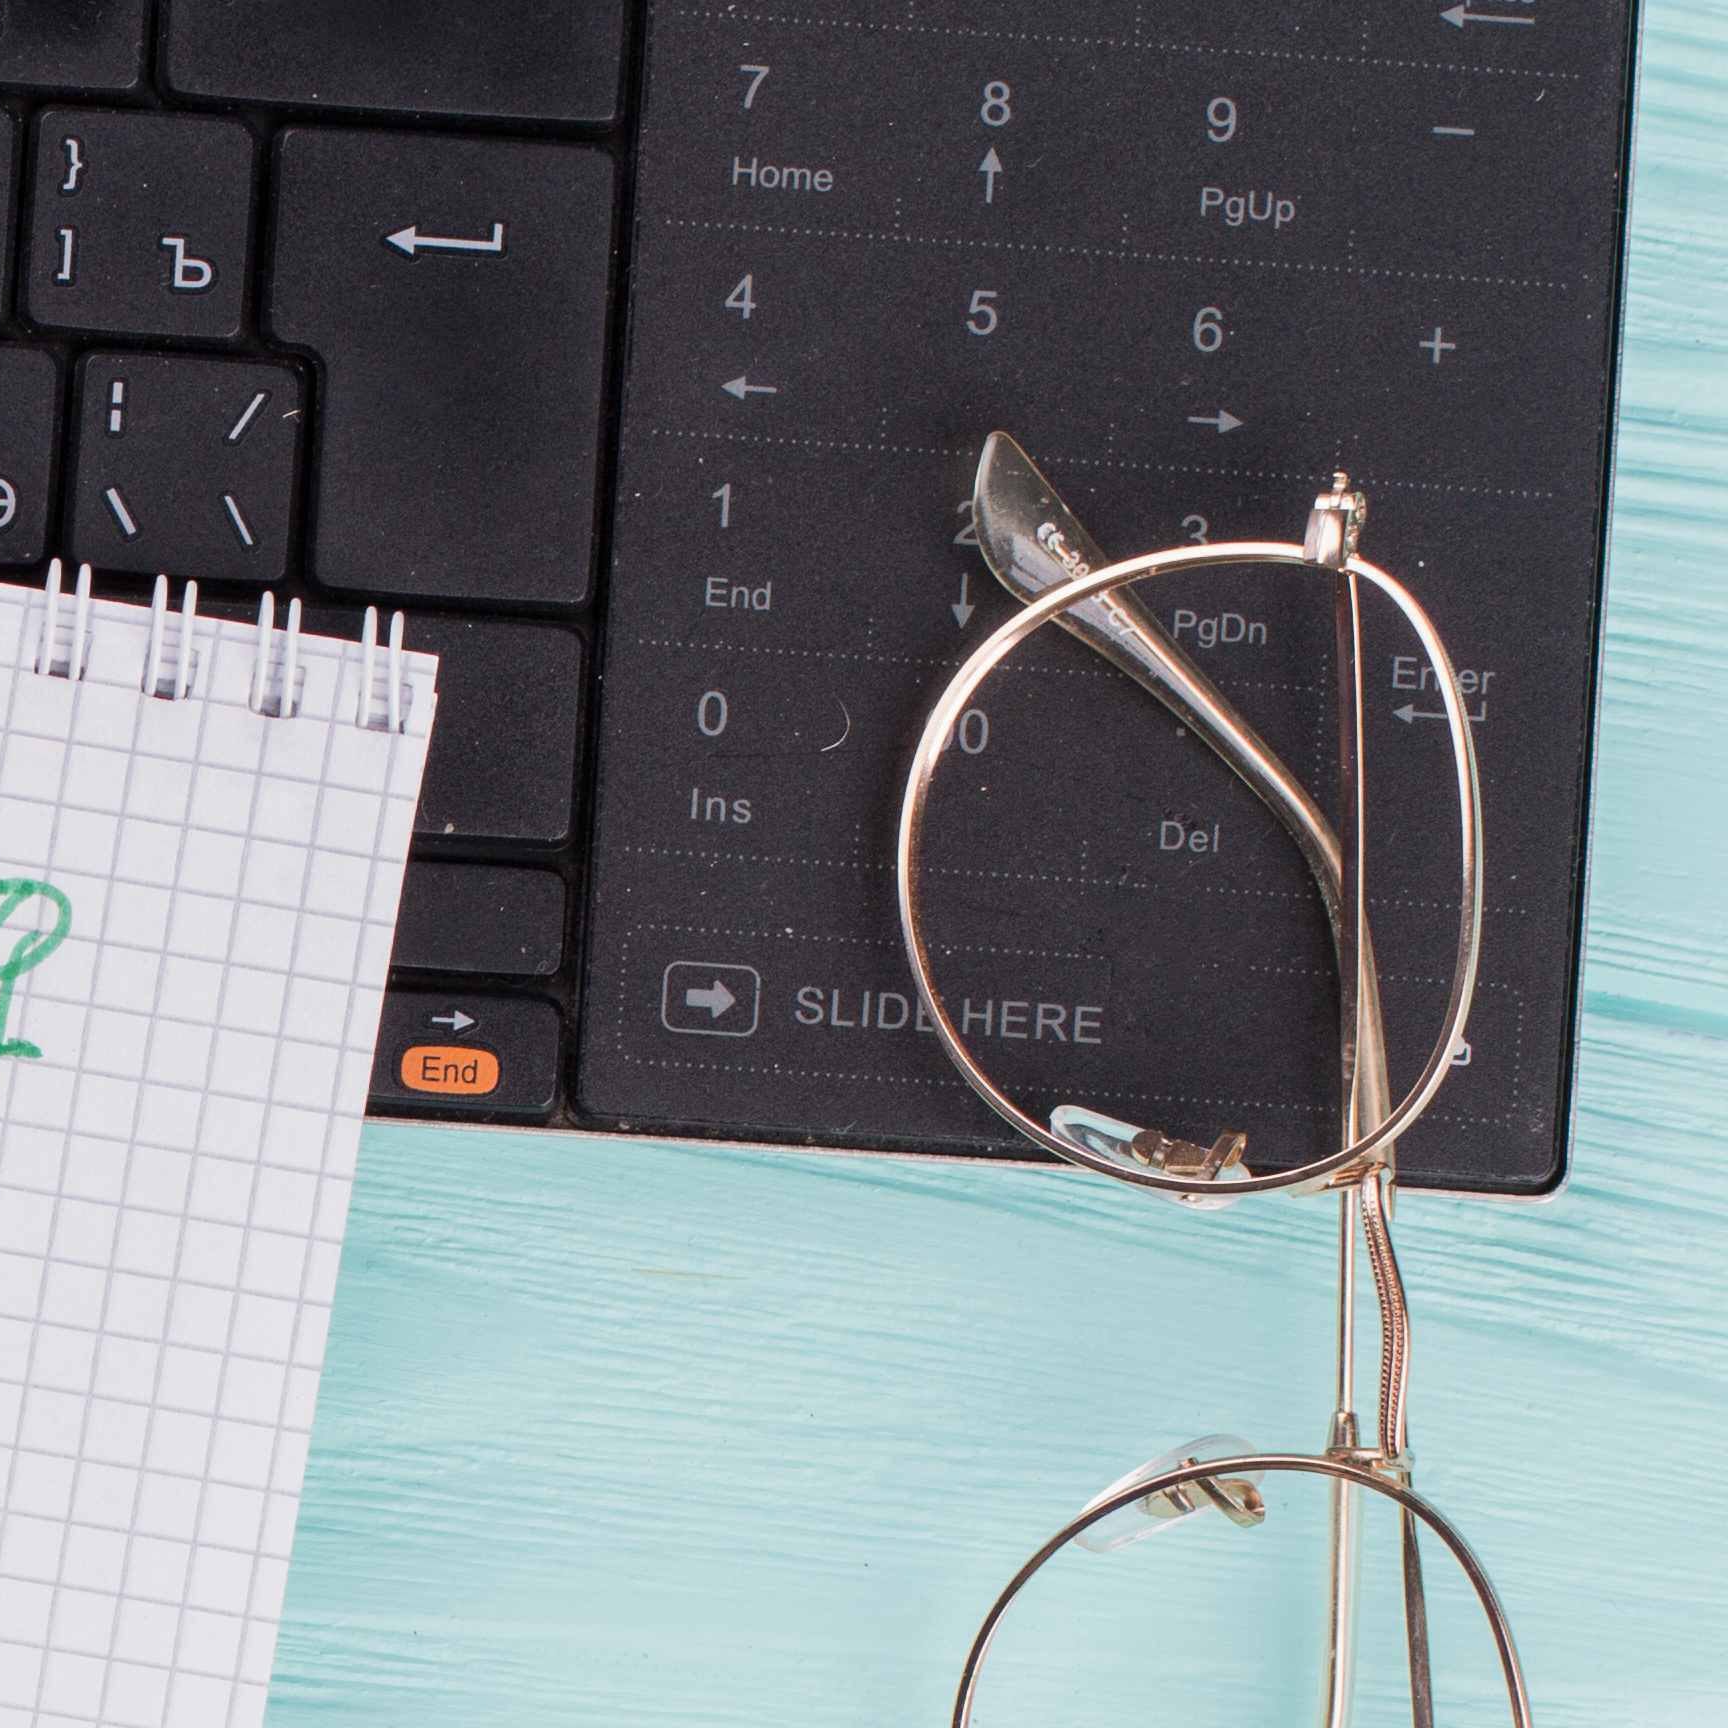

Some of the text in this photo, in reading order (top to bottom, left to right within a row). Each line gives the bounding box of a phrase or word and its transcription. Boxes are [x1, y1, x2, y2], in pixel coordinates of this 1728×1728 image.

[740, 64, 770, 109] 7
[980, 80, 1011, 127] 8
[1207, 97, 1237, 142] 9
[732, 155, 834, 192] Home
[1200, 186, 1296, 230] PgUp
[162, 237, 212, 288] Ъ
[724, 273, 757, 319] 4
[966, 290, 998, 335] 5
[1193, 306, 1223, 353] 6
[711, 482, 731, 528] 1
[705, 576, 772, 611] End
[1170, 609, 1267, 649] PgDn
[697, 690, 729, 737] 0
[690, 787, 753, 824] Ins
[1159, 817, 1220, 853] Del
[961, 997, 1104, 1045] HERE
[420, 1054, 480, 1086] End
